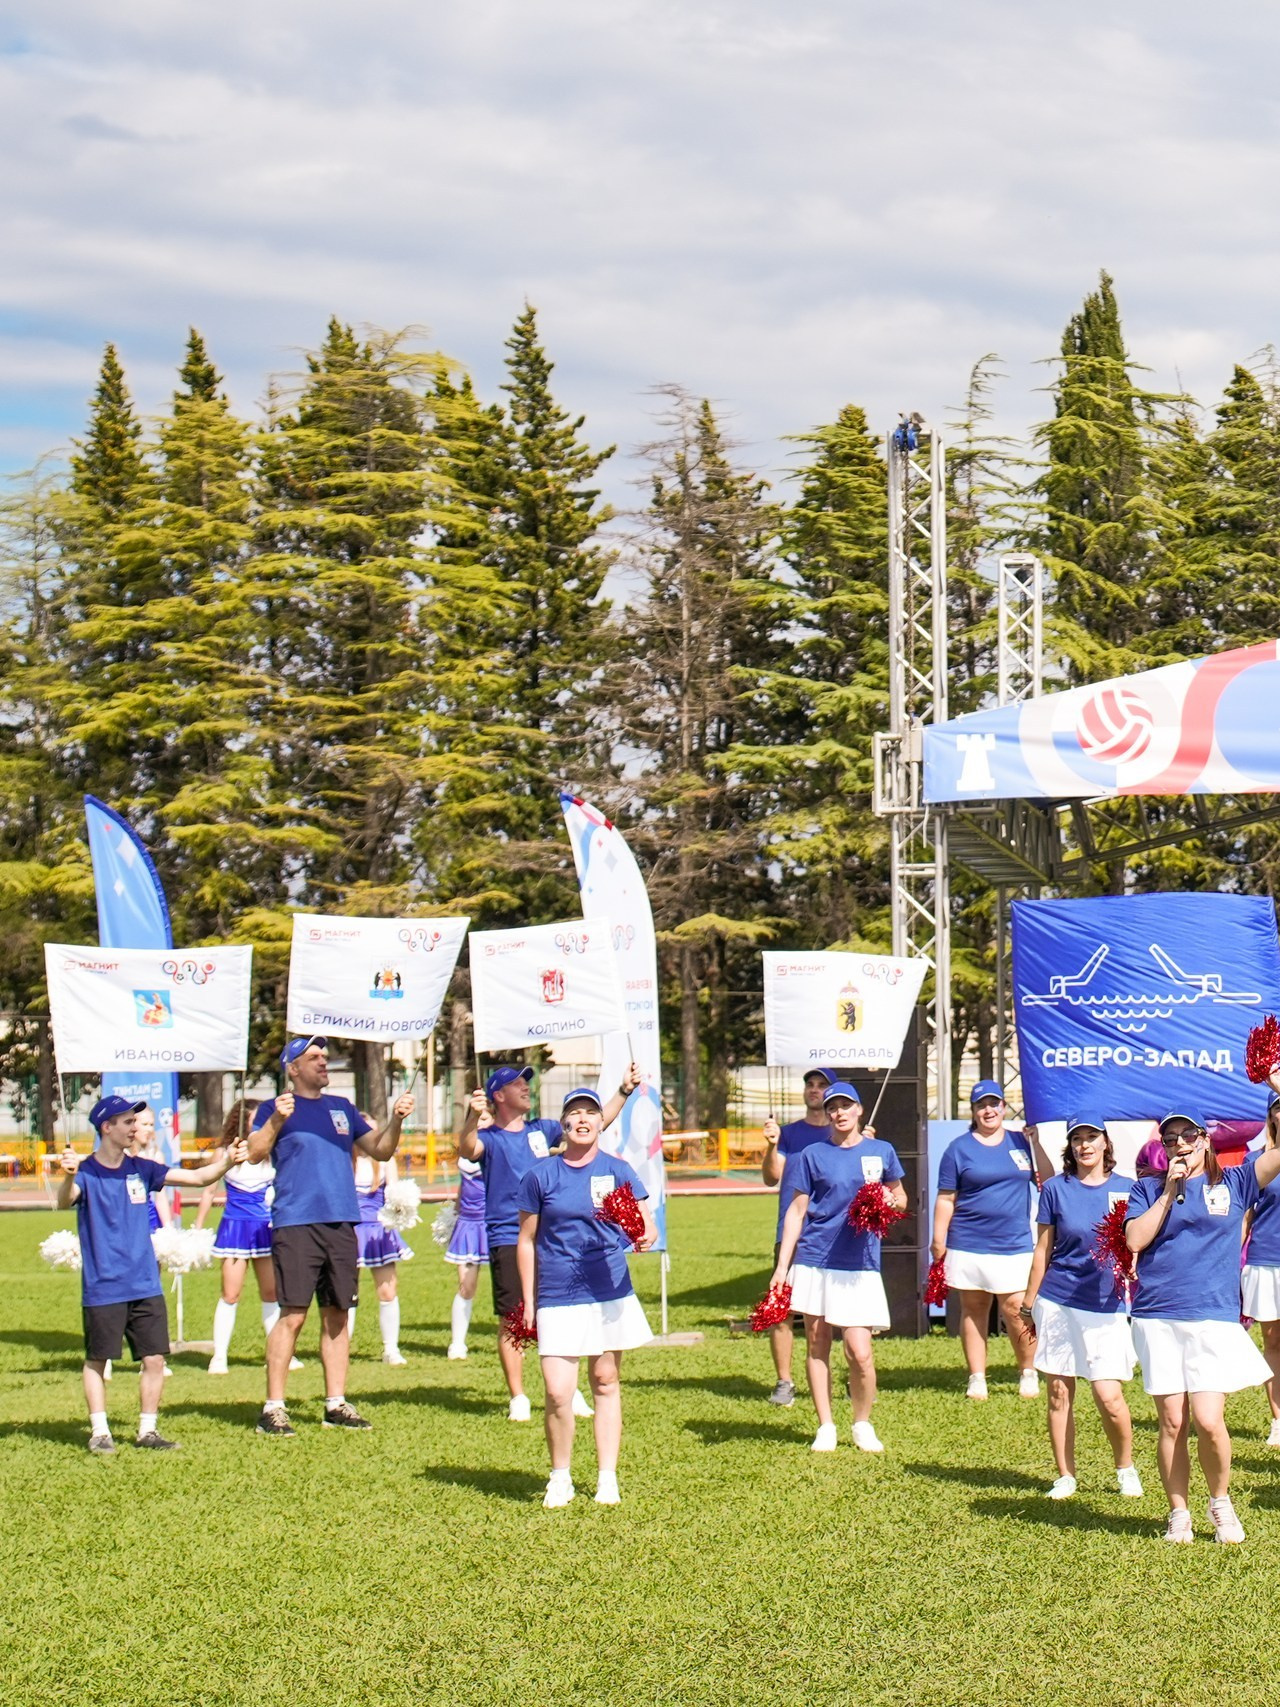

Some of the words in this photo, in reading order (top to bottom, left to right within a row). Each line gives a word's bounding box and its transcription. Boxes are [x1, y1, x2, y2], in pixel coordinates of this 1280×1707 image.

[324, 930, 361, 938] МАГНИТ
[78, 962, 120, 971] МАГНИТ
[302, 1013, 375, 1030] ВЕЛИКИЙ
[379, 1017, 435, 1031] НОВГОРО
[527, 1018, 586, 1036] КОЛПИНО
[114, 1049, 195, 1062] ИВАНОВО
[809, 1048, 894, 1059] ЯРОСЛАВЛЬ
[1041, 1046, 1234, 1072] СЕВЕРО-ЗАПАД
